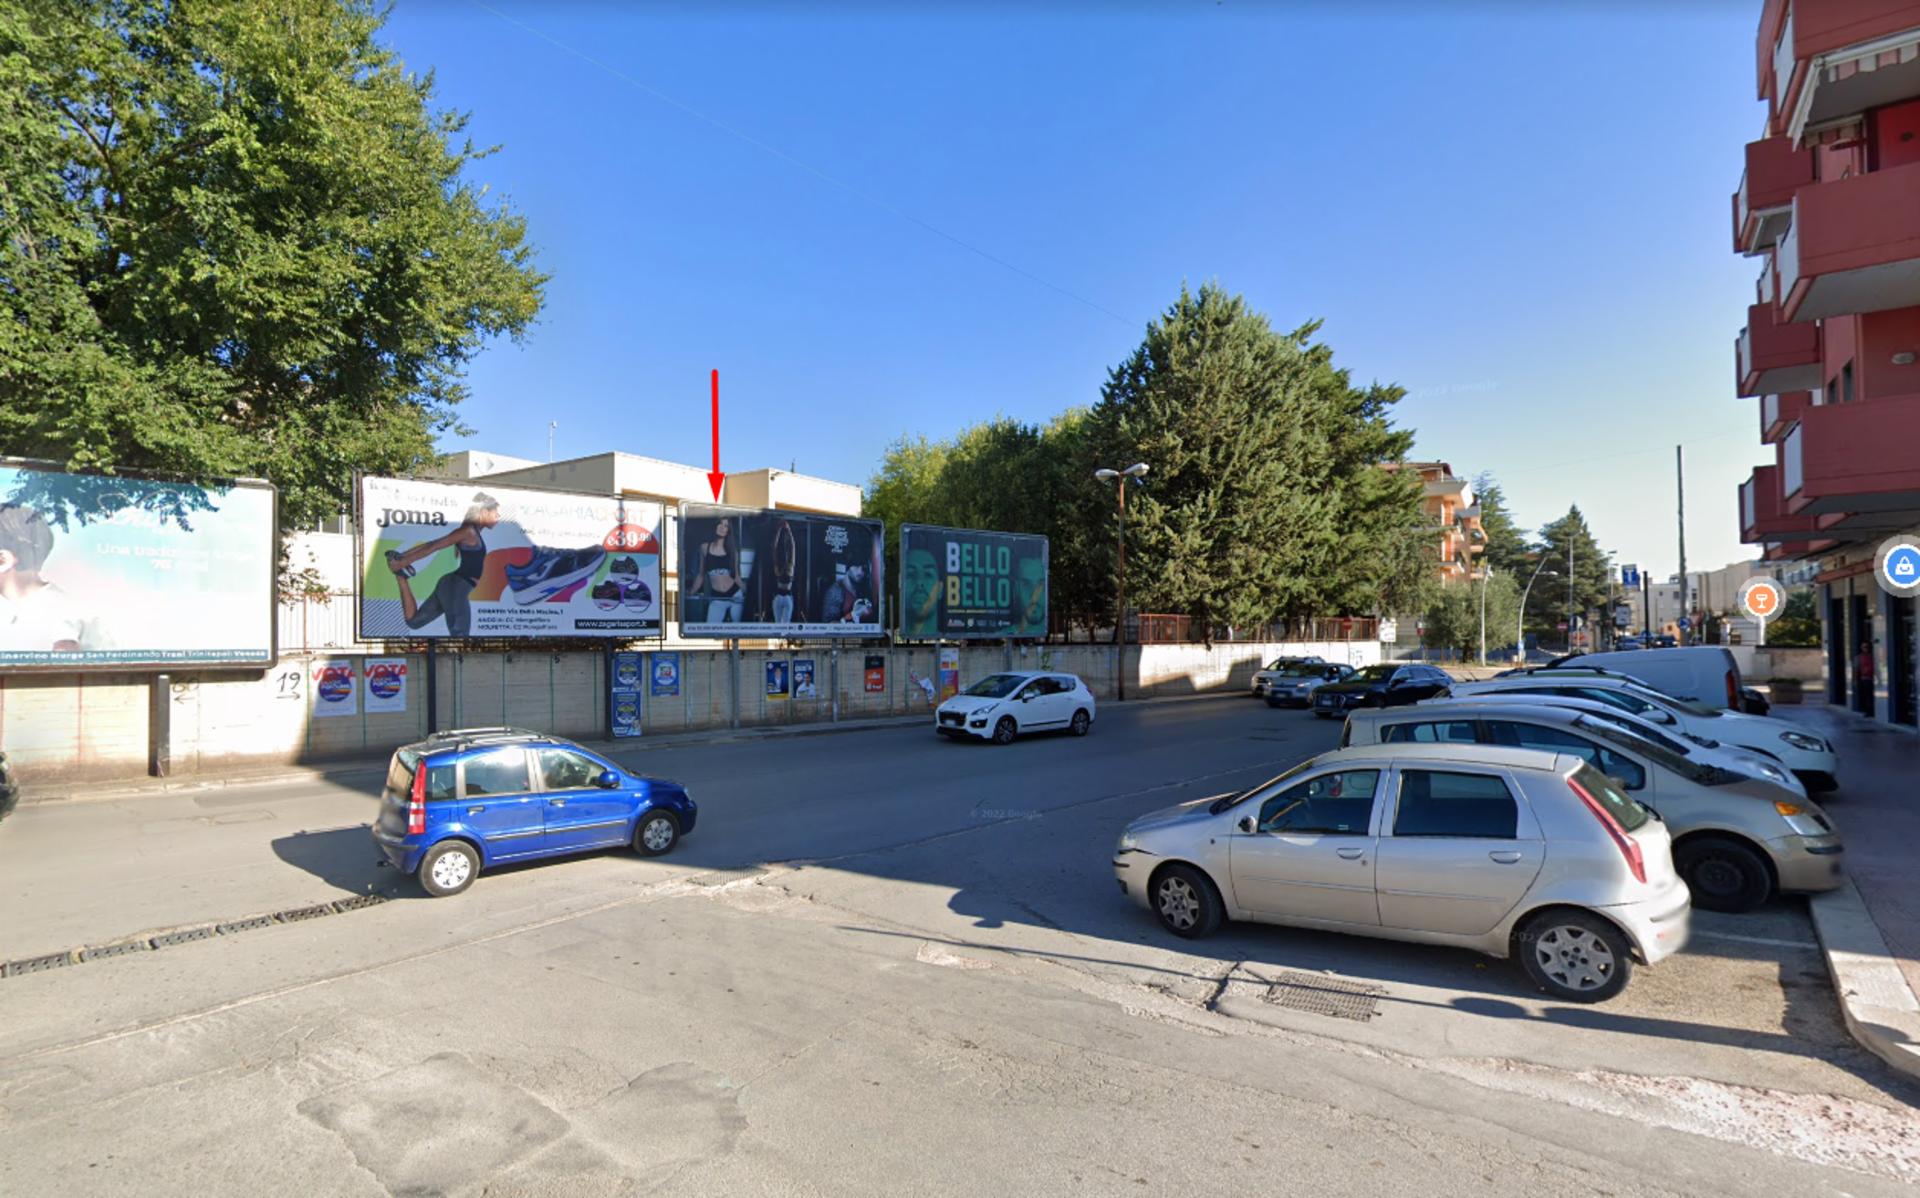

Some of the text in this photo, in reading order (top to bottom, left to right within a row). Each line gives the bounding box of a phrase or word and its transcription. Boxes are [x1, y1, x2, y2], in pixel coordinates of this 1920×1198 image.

[376, 507, 448, 528] Joma
[946, 541, 1011, 575] BELLO
[946, 575, 1011, 608] BELLO
[0, 652, 48, 660] inervino
[364, 663, 408, 678] VOTA
[277, 672, 301, 693] 19
